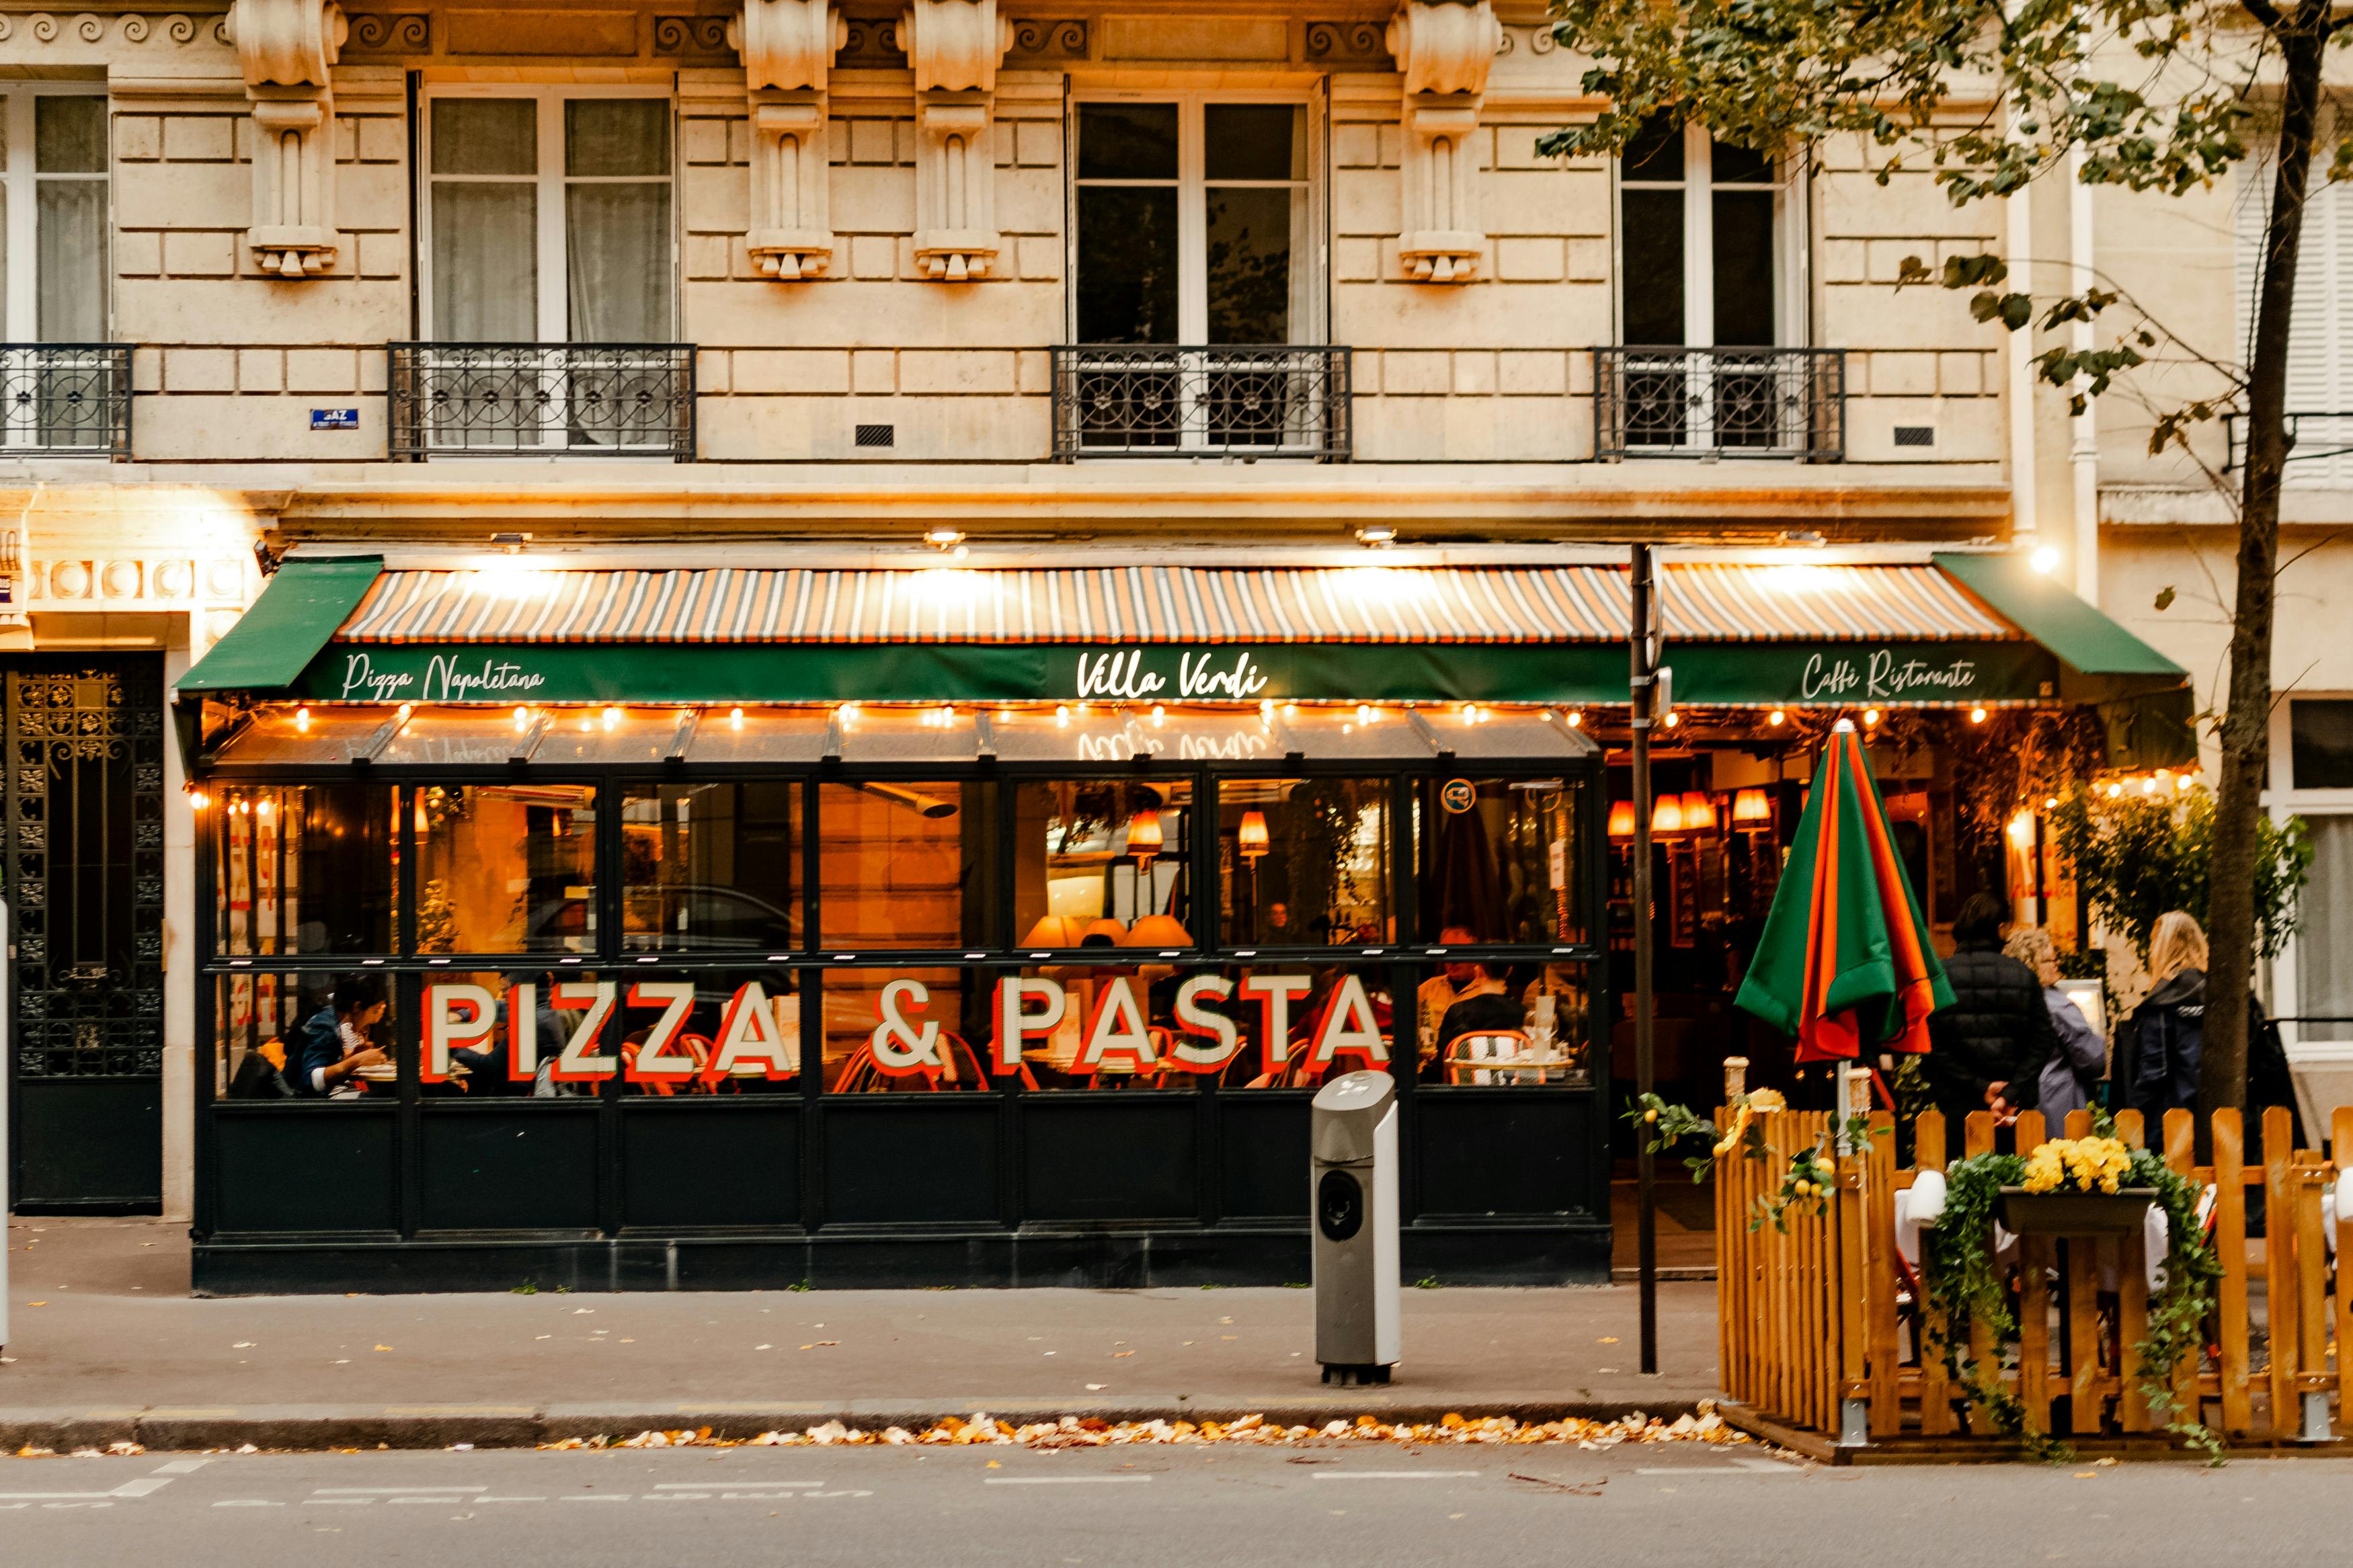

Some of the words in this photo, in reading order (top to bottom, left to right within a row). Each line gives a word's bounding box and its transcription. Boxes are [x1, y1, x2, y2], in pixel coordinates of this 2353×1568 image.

[342, 653, 413, 701] Pizza
[422, 654, 545, 701] Napoletana
[1077, 649, 1166, 698] Villa
[1179, 651, 1268, 698] Verdi
[1867, 649, 1977, 698] Ristorante
[421, 981, 796, 1083] PIZZA
[869, 978, 944, 1077] &
[992, 974, 1392, 1077] PASTA
